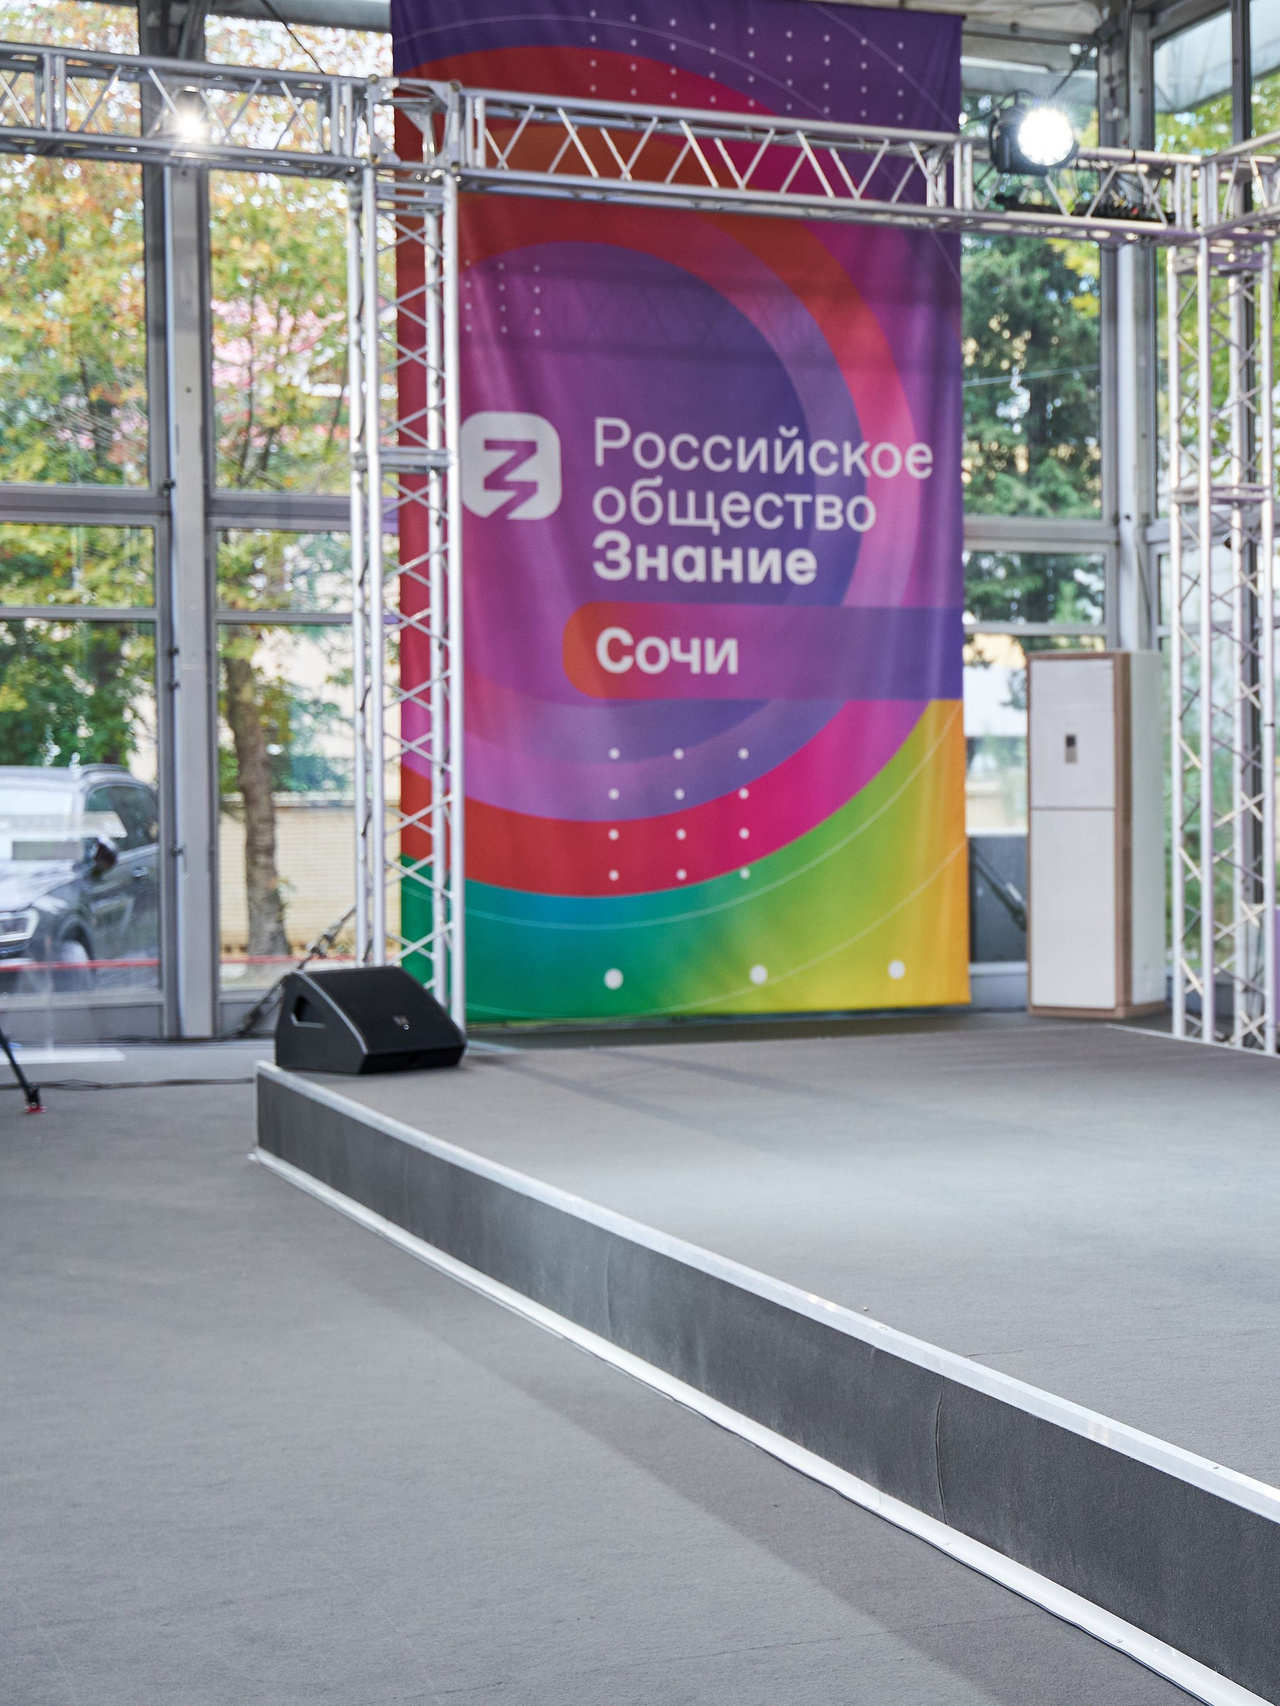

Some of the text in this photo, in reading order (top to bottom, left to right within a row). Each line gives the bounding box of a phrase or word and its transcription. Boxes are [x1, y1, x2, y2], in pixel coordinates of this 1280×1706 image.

[592, 416, 934, 480] Российское
[592, 477, 876, 536] общество
[592, 531, 818, 585] Знание
[596, 627, 738, 675] Сочи
